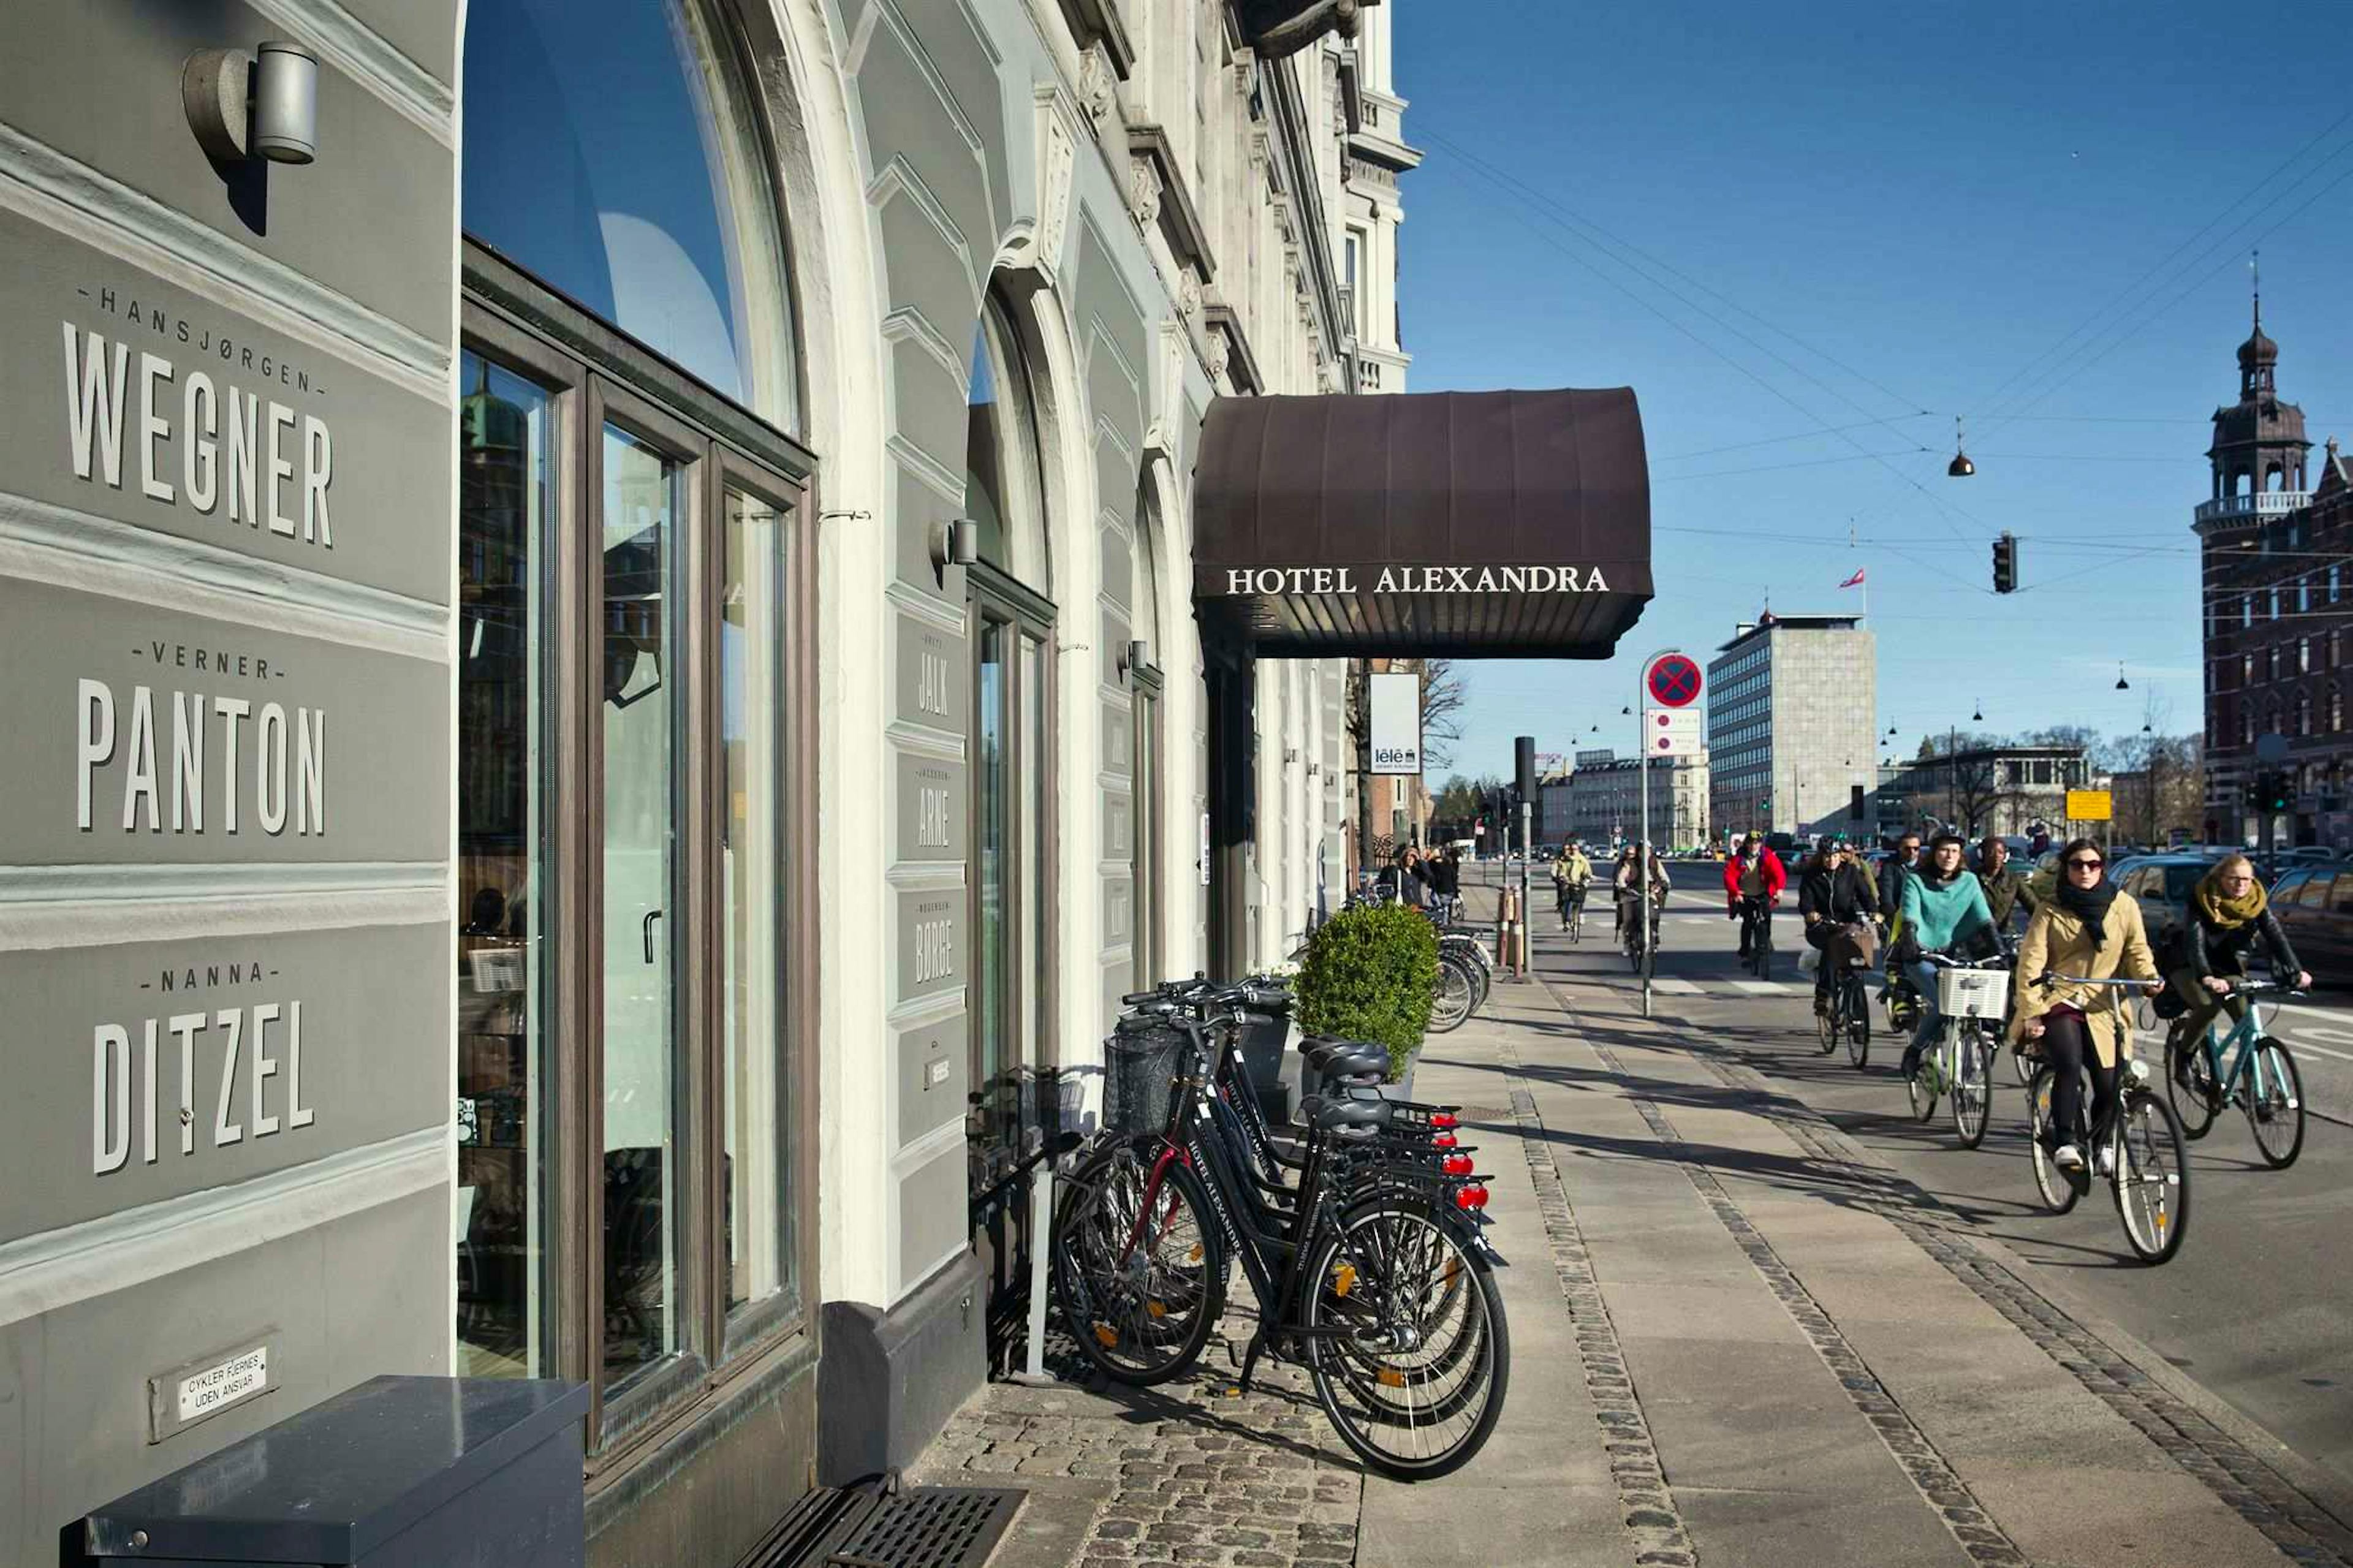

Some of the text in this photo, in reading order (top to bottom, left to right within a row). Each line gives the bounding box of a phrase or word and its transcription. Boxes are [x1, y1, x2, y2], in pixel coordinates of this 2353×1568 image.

[63, 320, 333, 550] WEGNER
[1226, 566, 1610, 595] HOTEL ALEXANDRA
[919, 651, 949, 716] JALK
[77, 678, 325, 836] PANTON
[919, 787, 949, 847] ARNE
[94, 1000, 315, 1176] DITZEL
[1189, 1140, 1244, 1257] HOTEL ALEXANDRA
[189, 1355, 258, 1393] CYKLER FJERNES
[195, 1374, 252, 1407] UDEN ANSVAR
